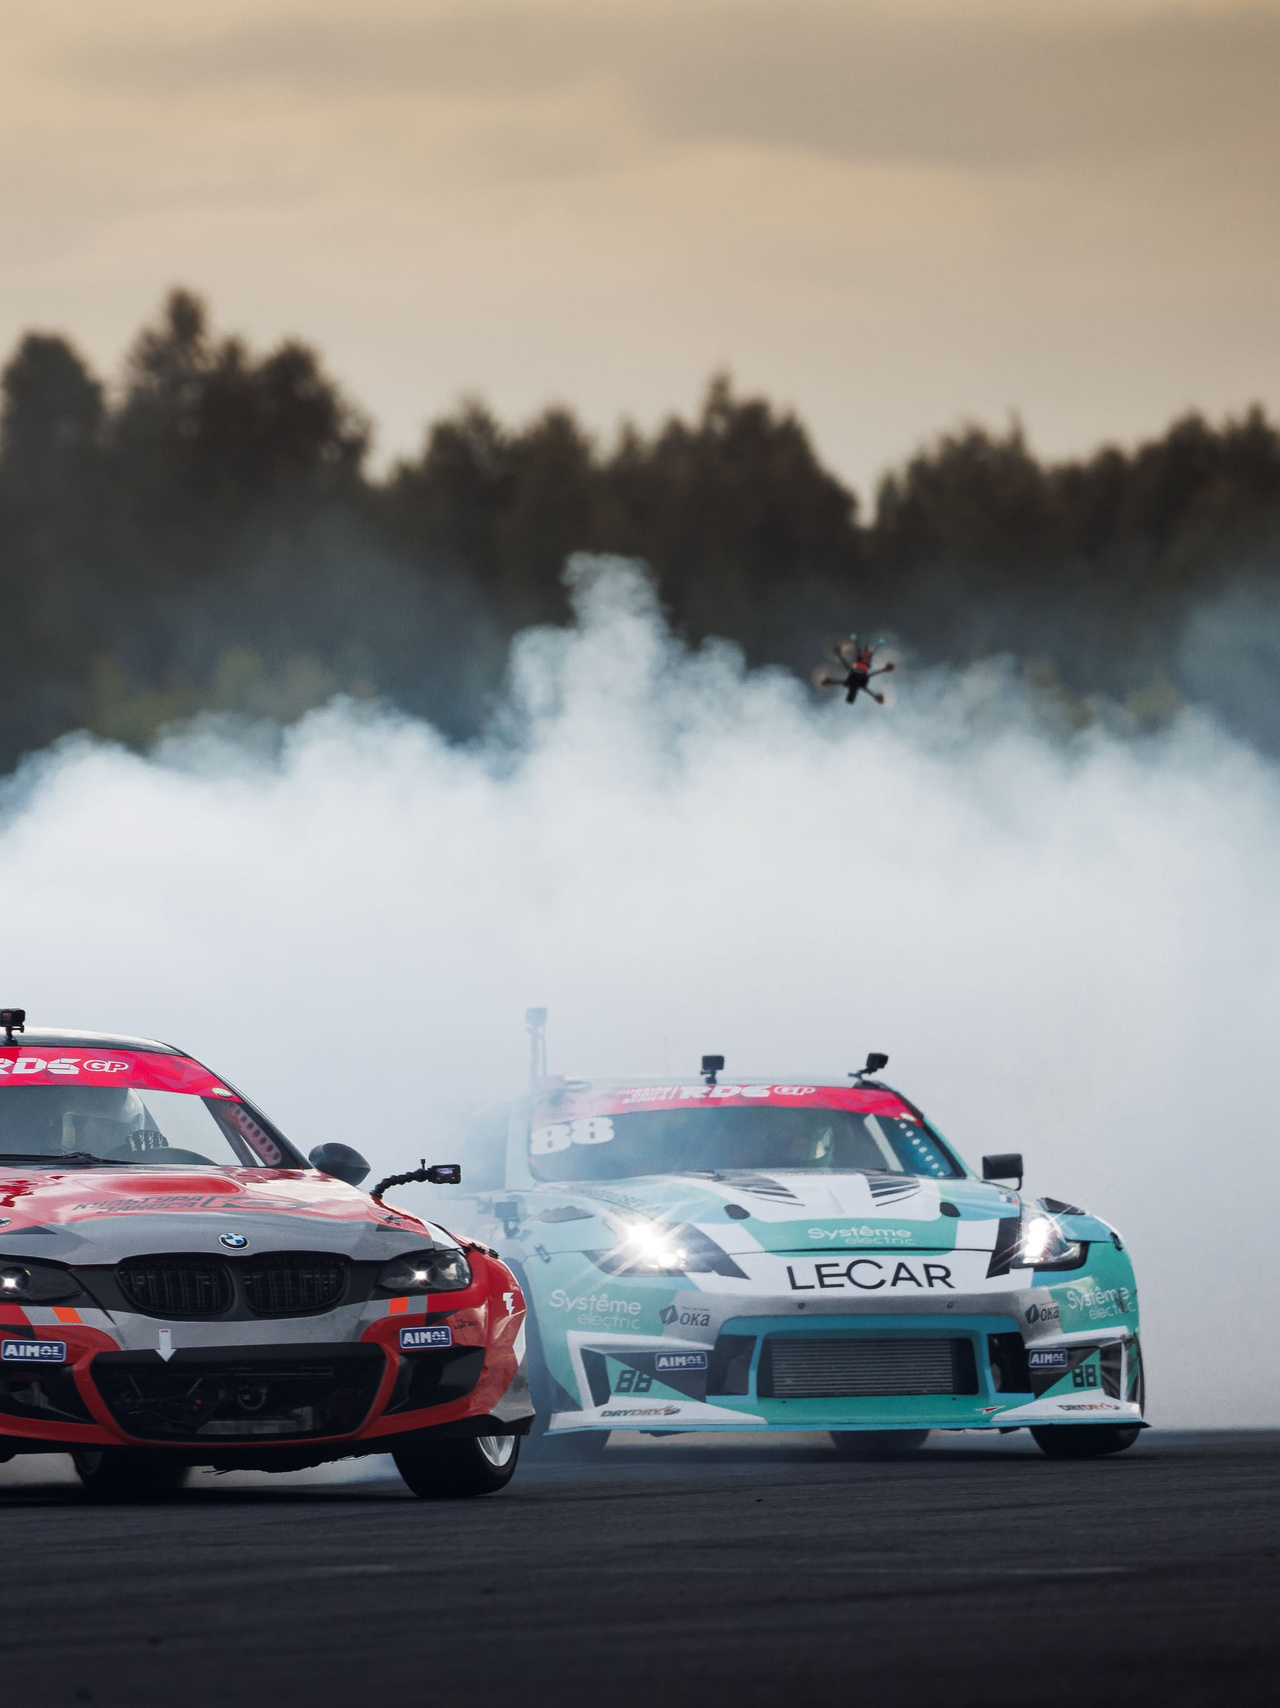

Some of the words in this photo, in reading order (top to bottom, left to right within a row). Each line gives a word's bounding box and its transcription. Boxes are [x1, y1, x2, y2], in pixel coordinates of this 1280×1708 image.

[84, 1059, 129, 1073] GP
[530, 1116, 615, 1155] 88
[73, 1196, 201, 1211] КУЛЬТУРА
[845, 1233, 915, 1246] electric
[786, 1259, 956, 1291] LECAR
[577, 1310, 641, 1330] electric
[403, 1331, 449, 1345] AIMOL
[4, 1344, 63, 1358] AIMOL
[658, 1354, 705, 1368] AIMOL
[1031, 1353, 1065, 1364] AIMOL
[1072, 1364, 1098, 1388] 88
